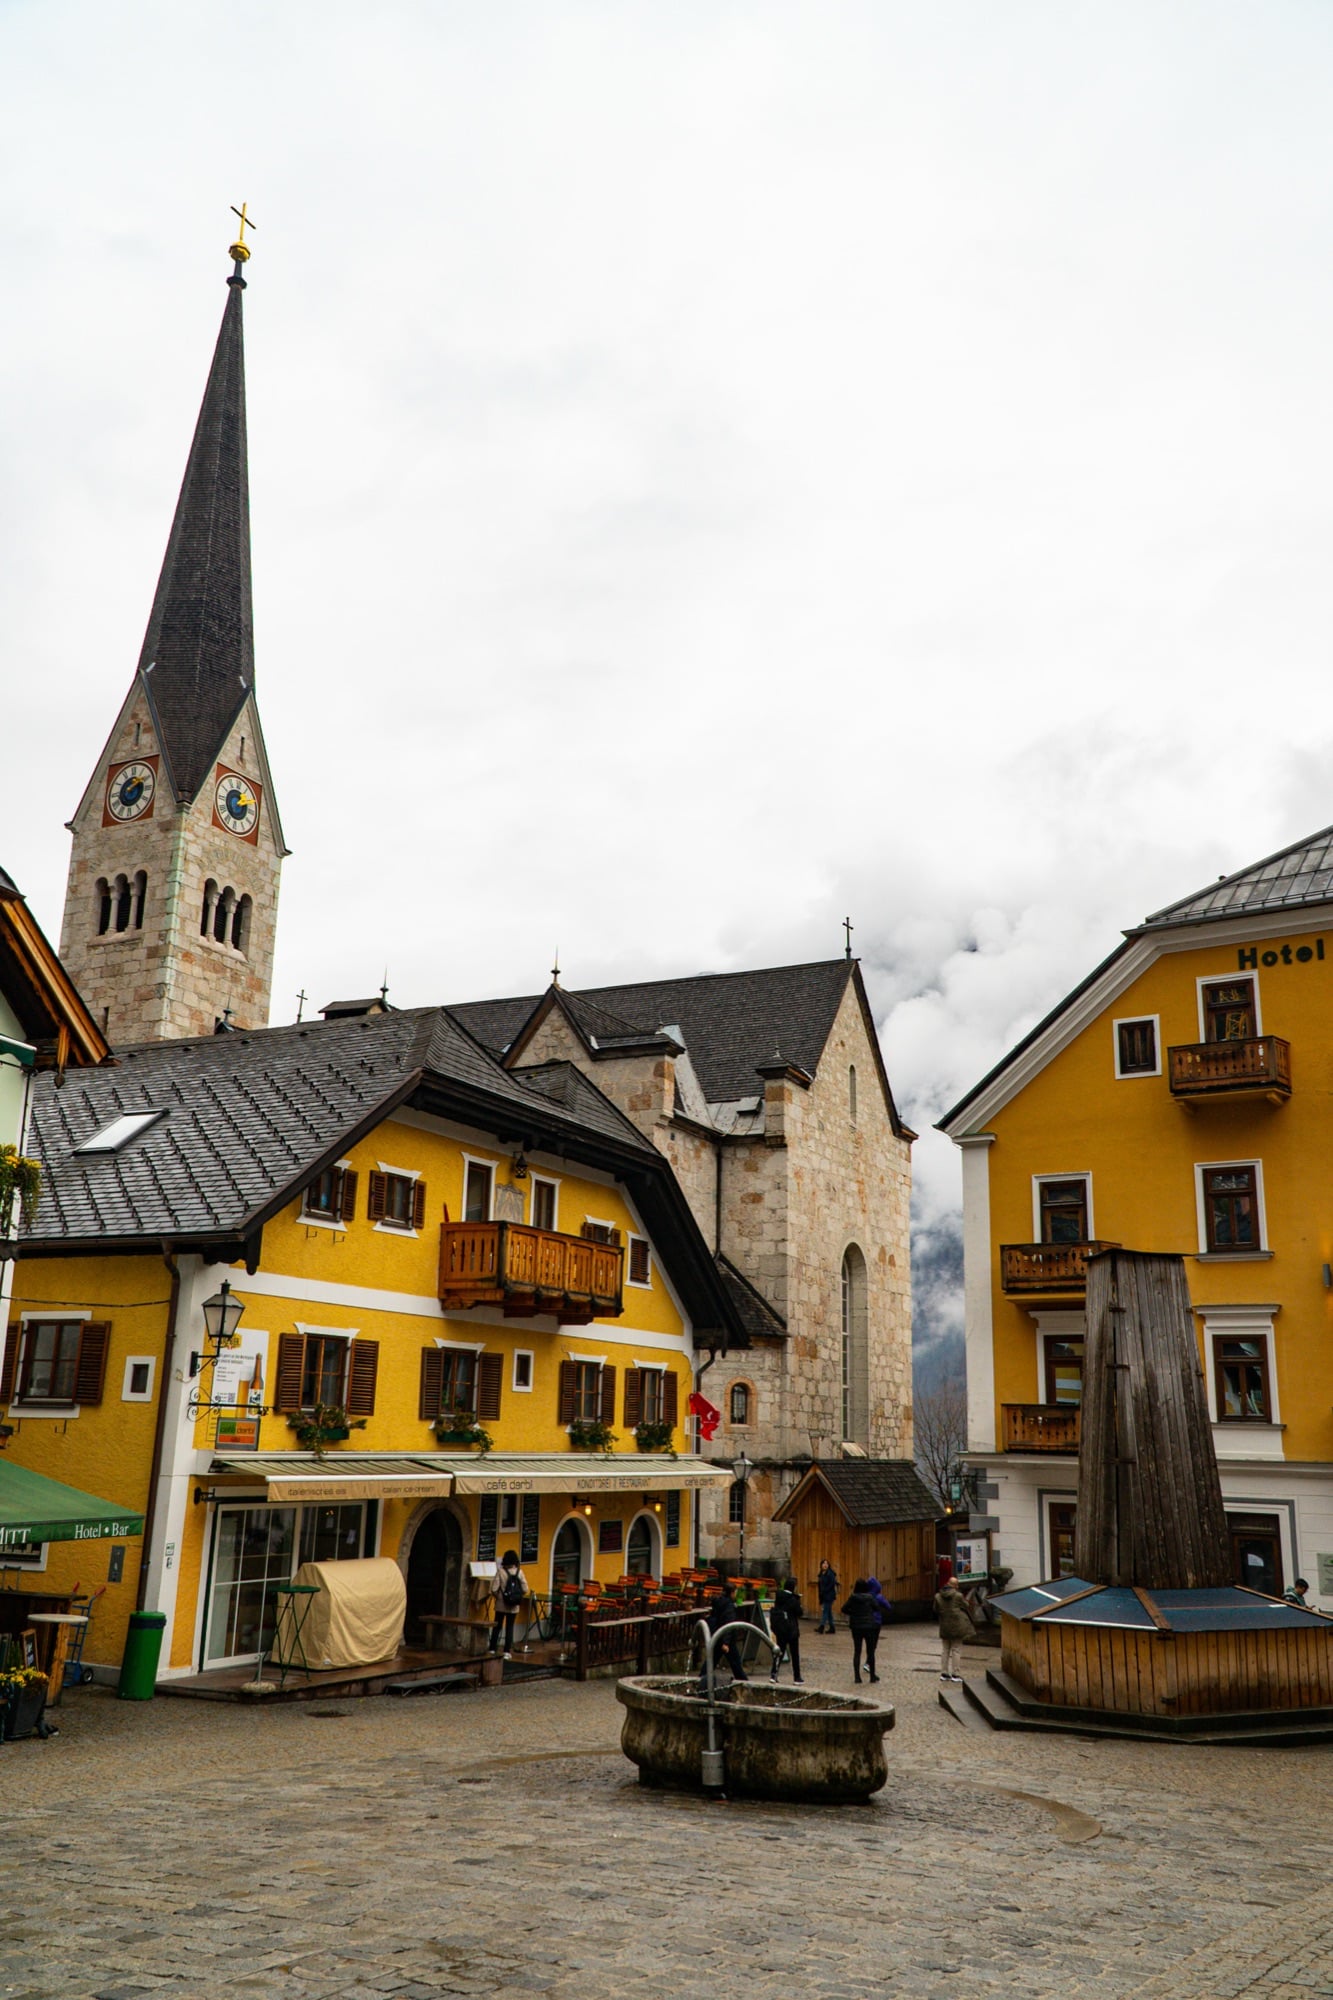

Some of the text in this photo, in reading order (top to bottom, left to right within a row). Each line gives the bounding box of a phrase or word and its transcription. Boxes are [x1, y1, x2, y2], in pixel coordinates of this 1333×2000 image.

[1238, 939, 1325, 970] Hotel
[487, 1479, 506, 1490] café
[75, 1523, 101, 1539] Hotel
[112, 1522, 129, 1537] Bar
